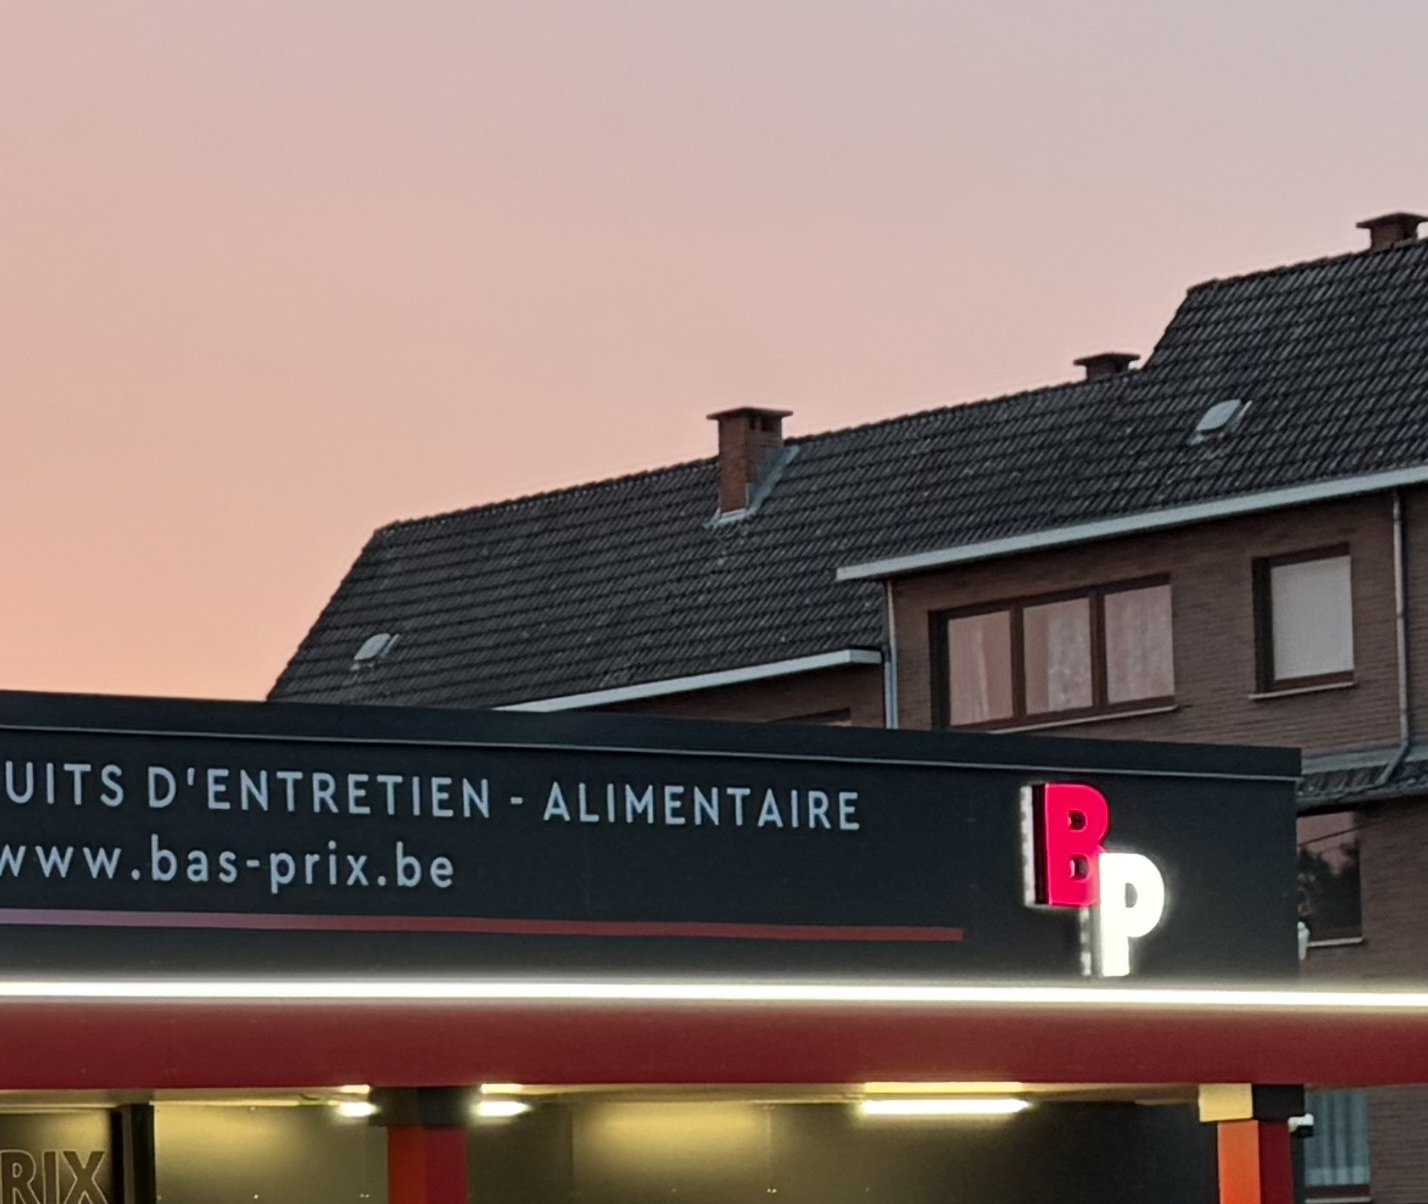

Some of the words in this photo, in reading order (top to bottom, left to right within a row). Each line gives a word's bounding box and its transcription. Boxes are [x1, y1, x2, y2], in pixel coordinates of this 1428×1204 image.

[148, 766, 491, 819] D'ENTRETIEN
[543, 782, 861, 831] ALIMENTAIRE
[1041, 783, 1166, 976] BP
